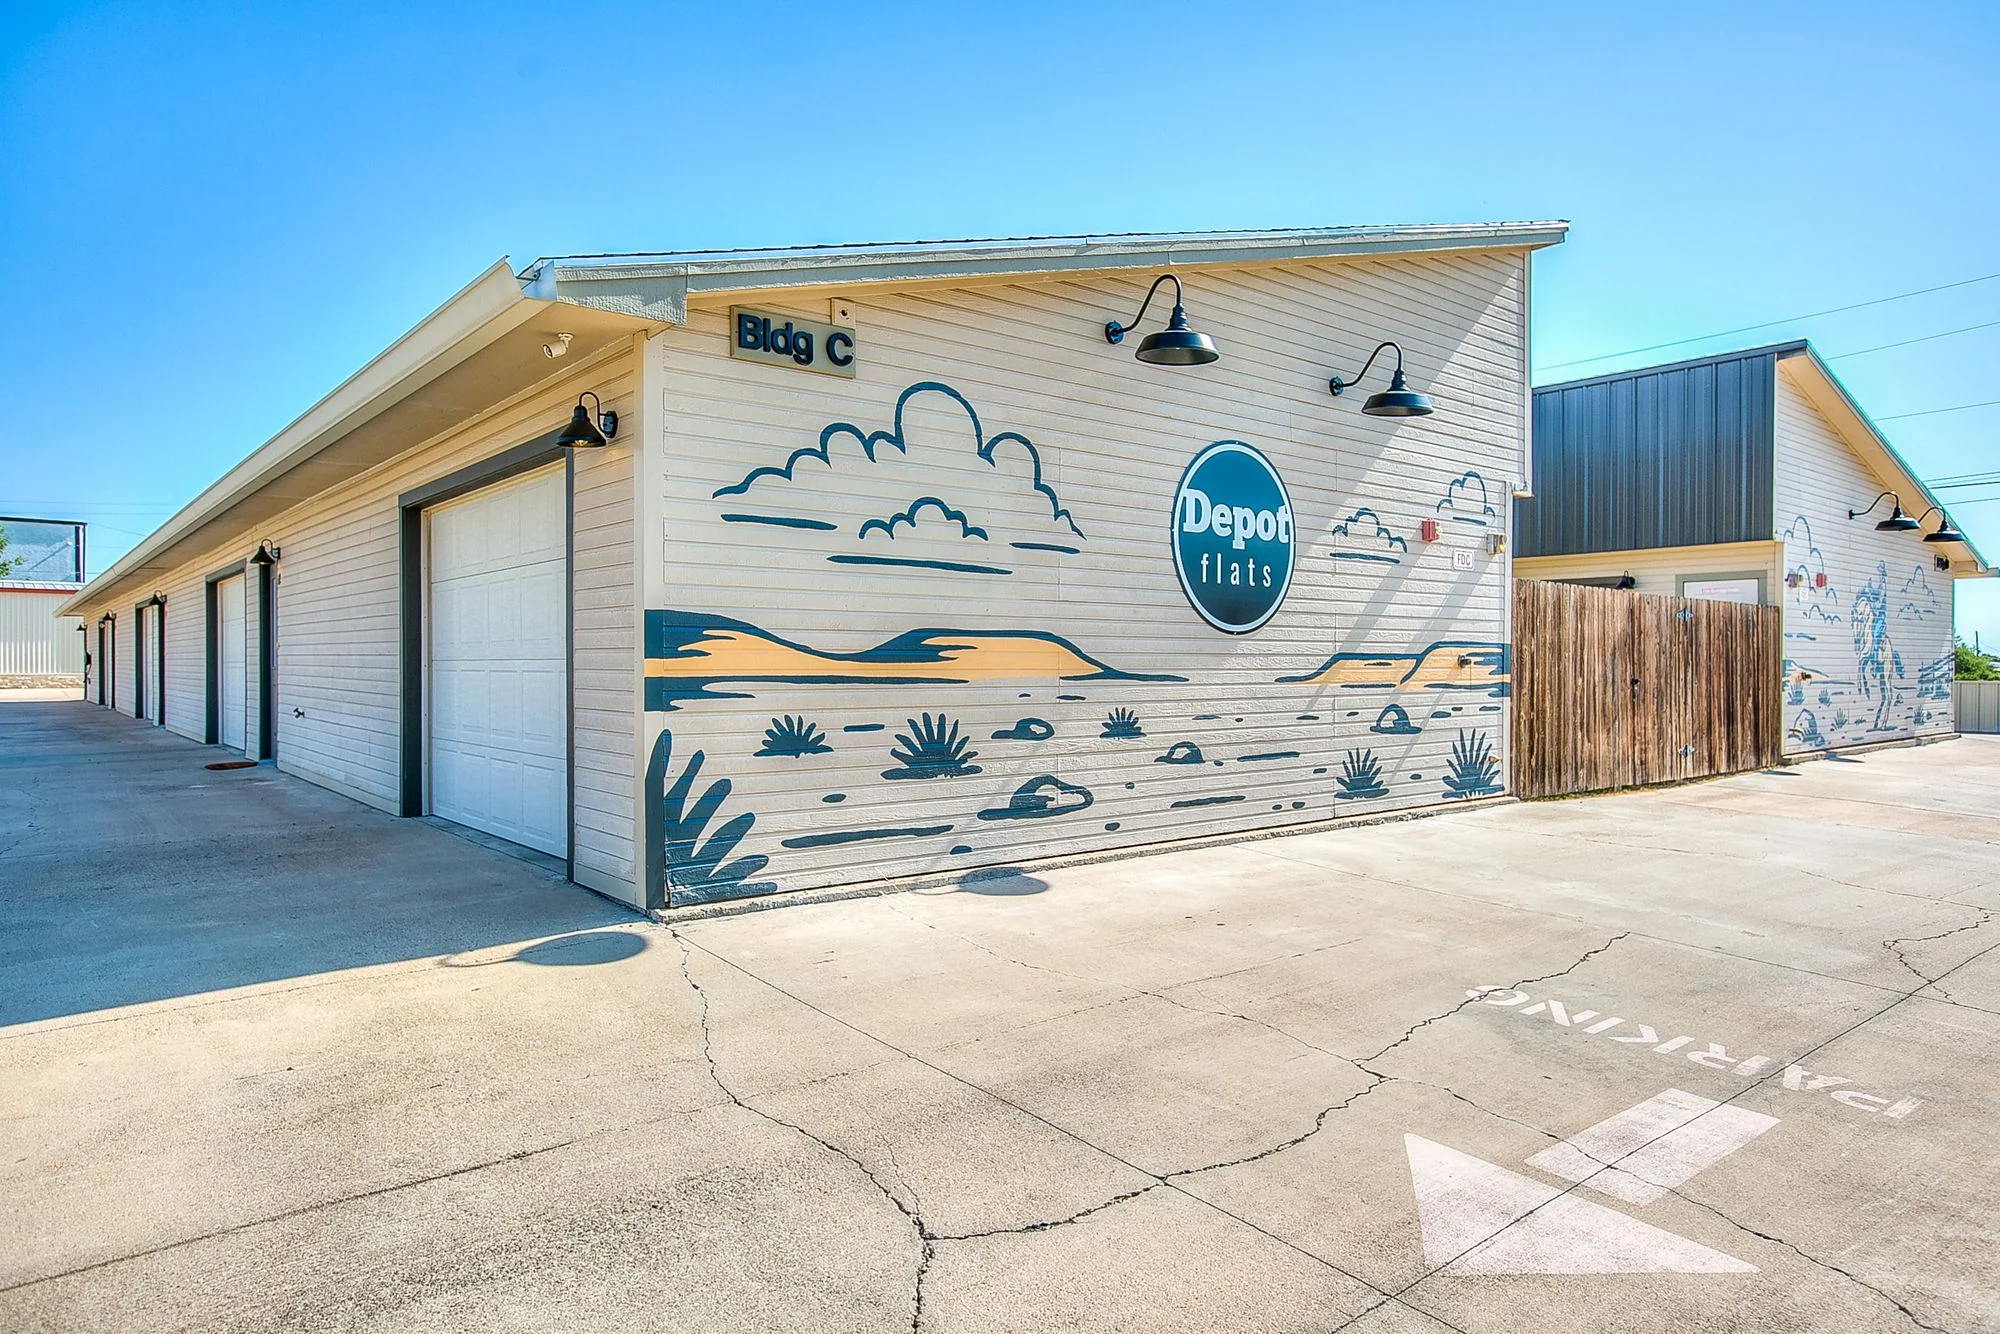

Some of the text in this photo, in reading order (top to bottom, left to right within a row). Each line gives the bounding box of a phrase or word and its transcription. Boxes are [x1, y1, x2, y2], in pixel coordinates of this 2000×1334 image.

[738, 313, 854, 367] Bldg C
[1181, 488, 1291, 549] Depot
[1201, 552, 1272, 588] flats
[1457, 553, 1471, 566] FDC
[1465, 985, 1924, 1119] PARKING
